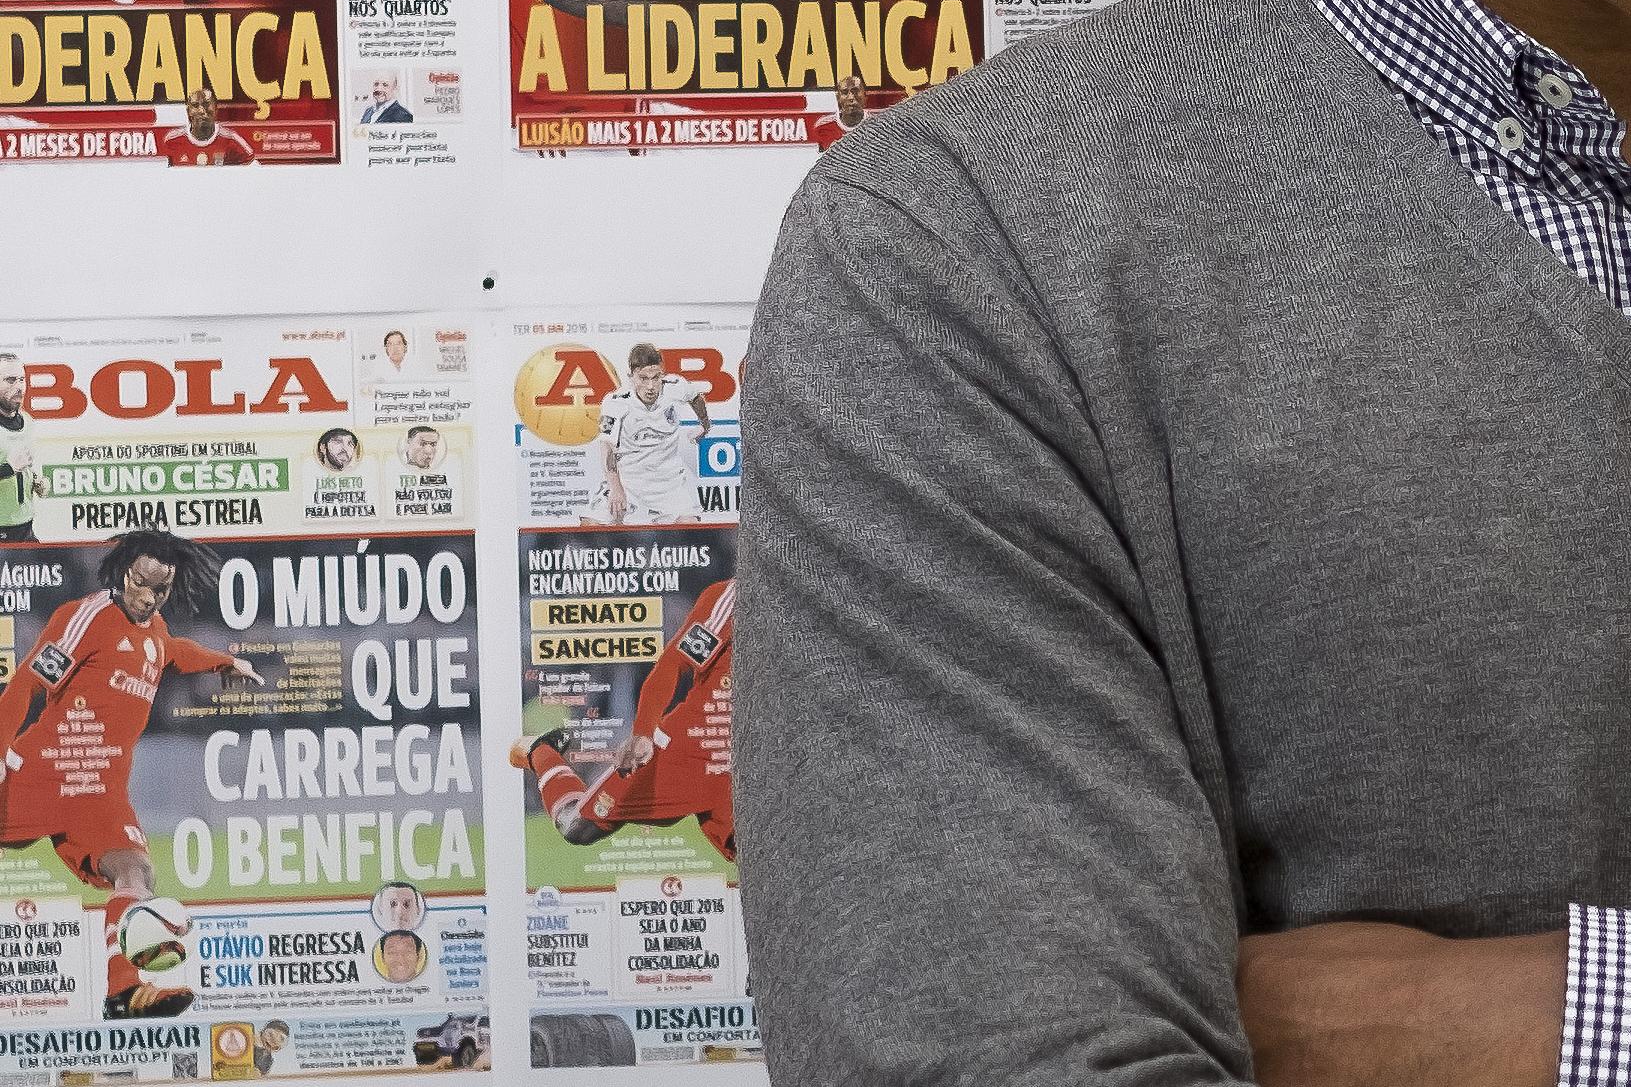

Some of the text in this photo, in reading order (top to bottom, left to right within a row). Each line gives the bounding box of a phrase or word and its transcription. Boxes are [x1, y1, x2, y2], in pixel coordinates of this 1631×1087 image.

[586, 0, 975, 100] LIDERANÇA
[20, 132, 157, 156] MESES DE FORA
[521, 115, 808, 145] LUISÃO MAIS MESES DE FORA
[21, 357, 348, 420] BOLA
[535, 349, 620, 406] A
[52, 457, 279, 493] BRUNO CÉSAR
[72, 499, 262, 530] PREPARA ESTREIA
[529, 542, 710, 571] NOTÁVEIS DAS ÁGUIAS
[219, 538, 465, 630] O MIÚDO
[529, 570, 679, 594] ENCANTADOS COM
[548, 602, 647, 624] RENATO
[539, 637, 657, 660] SANCHES
[352, 637, 469, 719] QUE
[205, 723, 473, 801] CARREGA
[173, 810, 476, 890] O BENFICA
[200, 931, 365, 959] OTÁVIO REGRESSA
[215, 962, 359, 986] SUK INTERESSA
[635, 1006, 744, 1030] DESAFIO
[109, 1024, 200, 1051] DAKAR
